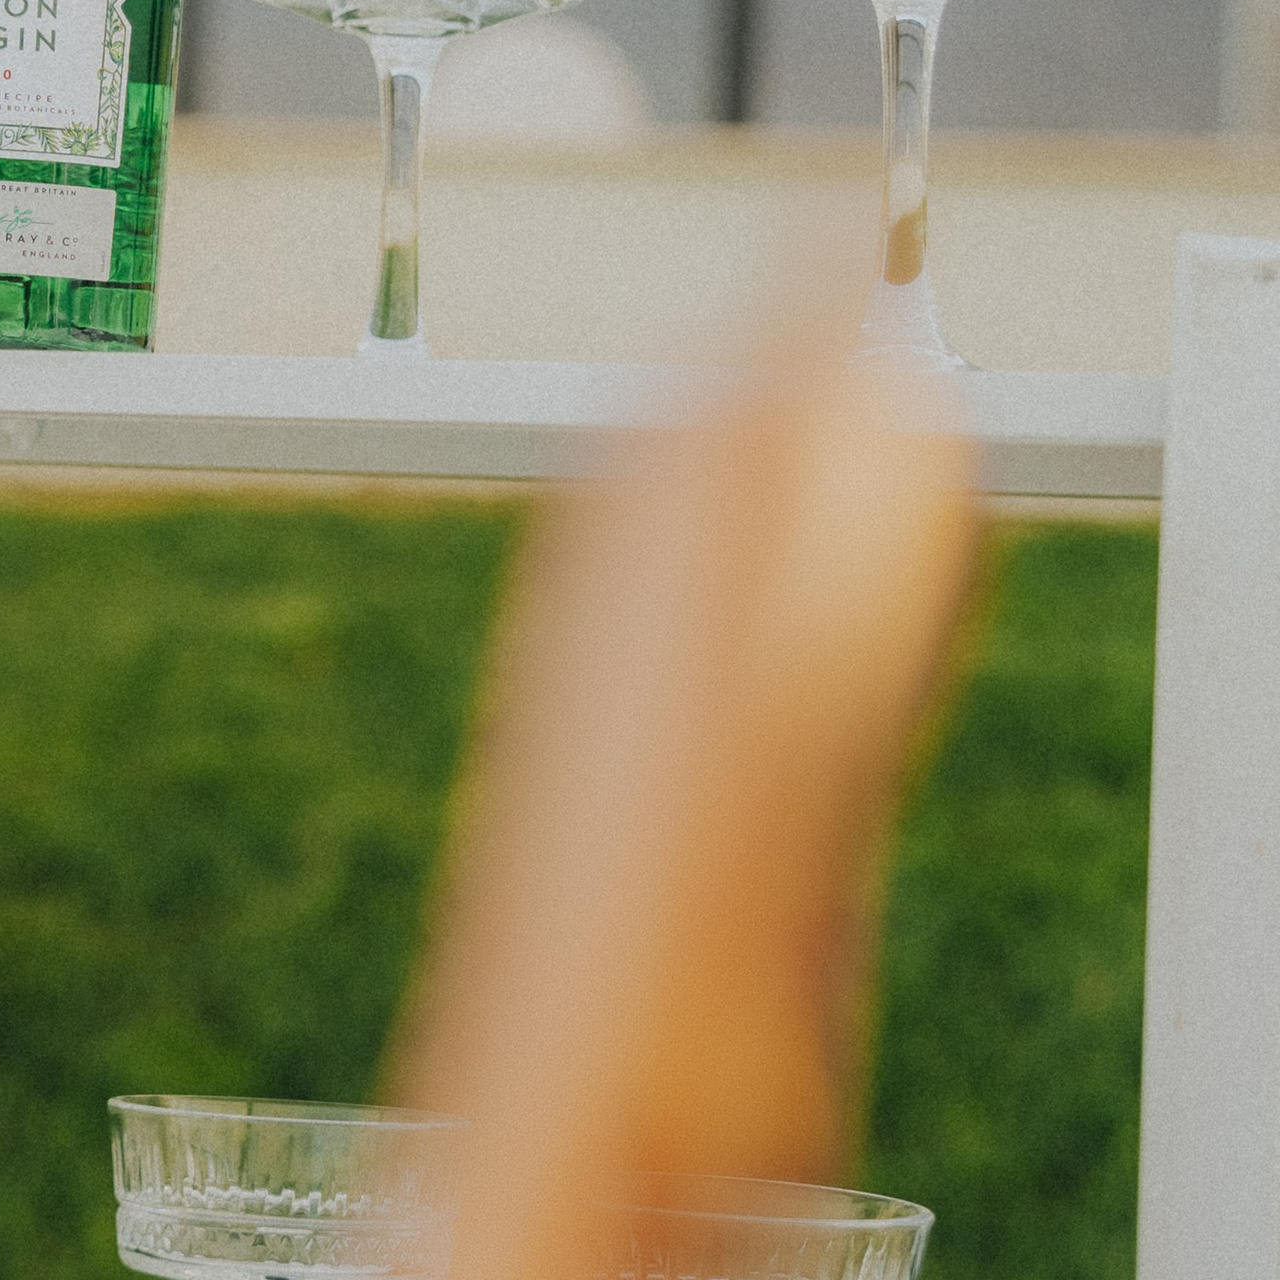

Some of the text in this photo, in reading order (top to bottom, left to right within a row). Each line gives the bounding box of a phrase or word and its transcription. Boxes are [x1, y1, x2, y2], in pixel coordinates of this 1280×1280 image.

[7, 105, 76, 116] BOTANICALS
[34, 187, 77, 197] BRITAIN
[46, 235, 54, 246] &
[22, 250, 76, 261] ENGLAND
